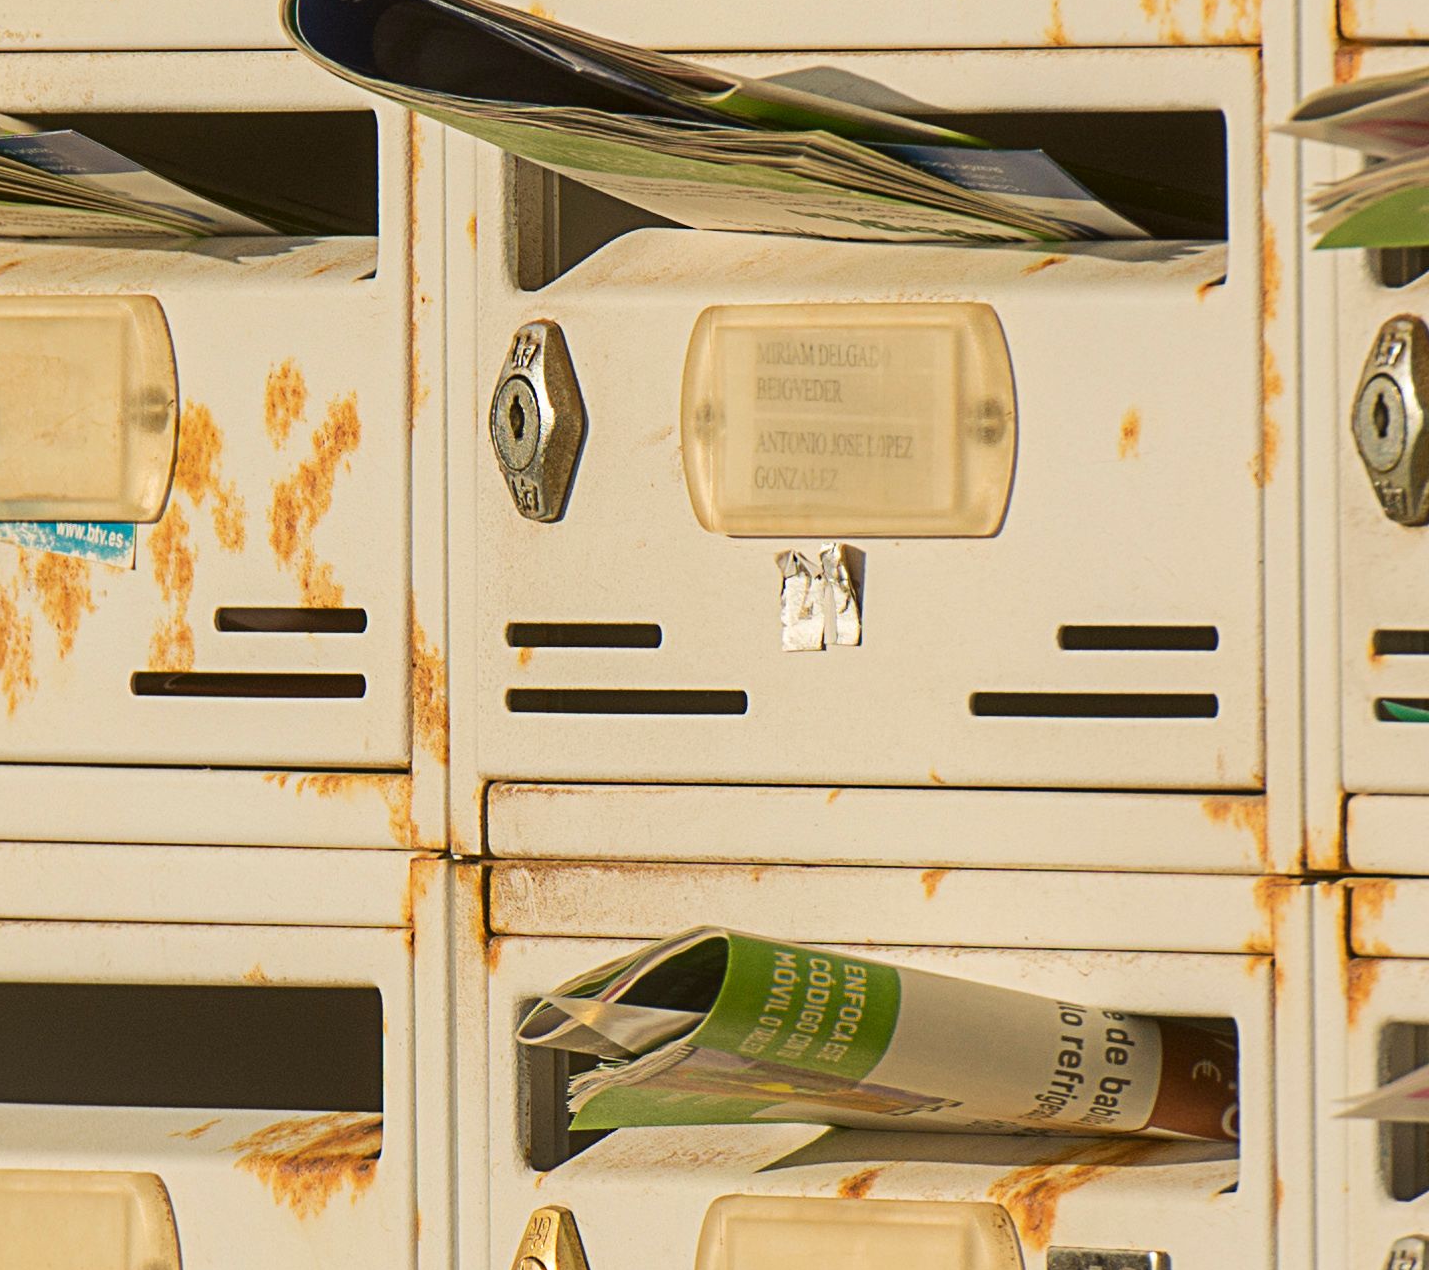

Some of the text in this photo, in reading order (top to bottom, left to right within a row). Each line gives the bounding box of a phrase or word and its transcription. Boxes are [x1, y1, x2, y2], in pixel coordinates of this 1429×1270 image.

[757, 342, 815, 367] MIRIAM
[755, 430, 827, 457] ANTONIO
[55, 521, 124, 549] www.btv.es
[764, 951, 801, 1013] MÓVIL
[795, 957, 836, 1034] CÓDIGO
[831, 964, 868, 1042] ENFOCA
[1104, 1027, 1135, 1066] de
